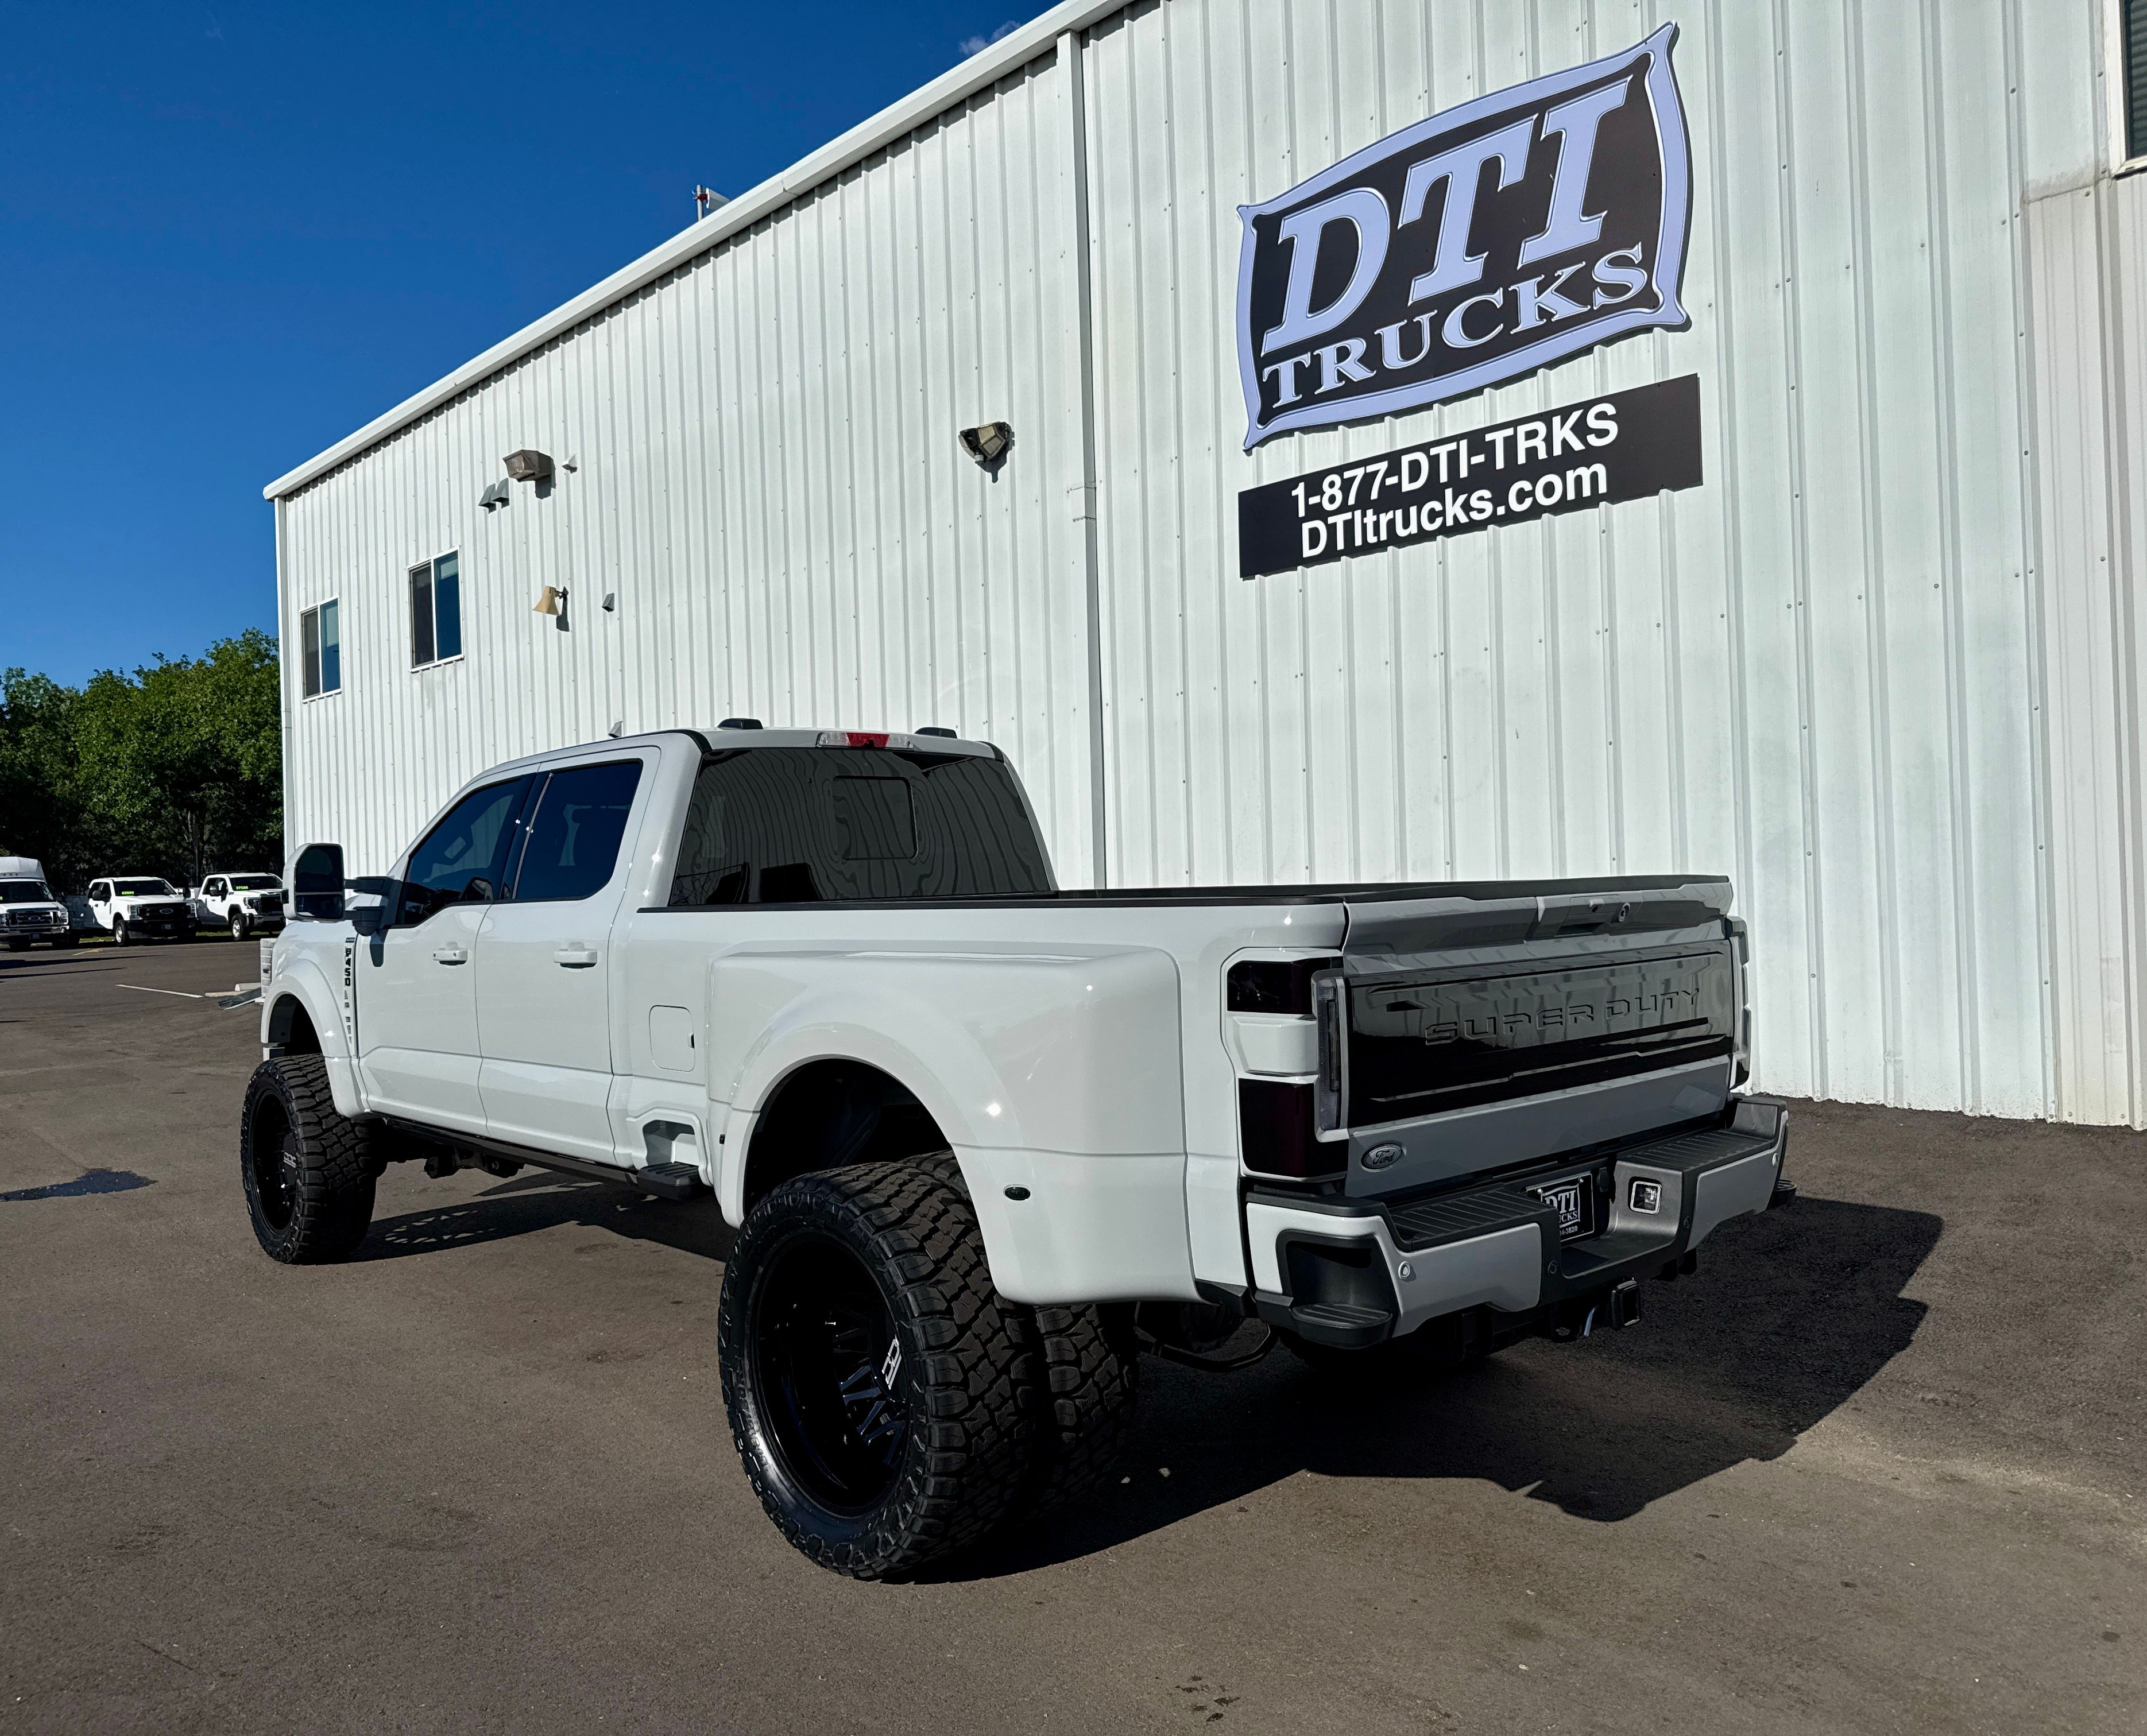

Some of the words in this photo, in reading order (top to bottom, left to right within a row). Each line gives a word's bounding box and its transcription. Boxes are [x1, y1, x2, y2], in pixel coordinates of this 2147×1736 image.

[1260, 75, 1633, 357] DTI
[1262, 242, 1647, 408] TRUCKS
[1291, 403, 1618, 517] 1-877-DTI-TRKS
[1302, 463, 1607, 557] DTItrucks.com
[1425, 1004, 1595, 1046] SUPER
[1606, 988, 1700, 1020] DUTY
[1372, 1149, 1395, 1165] Ford
